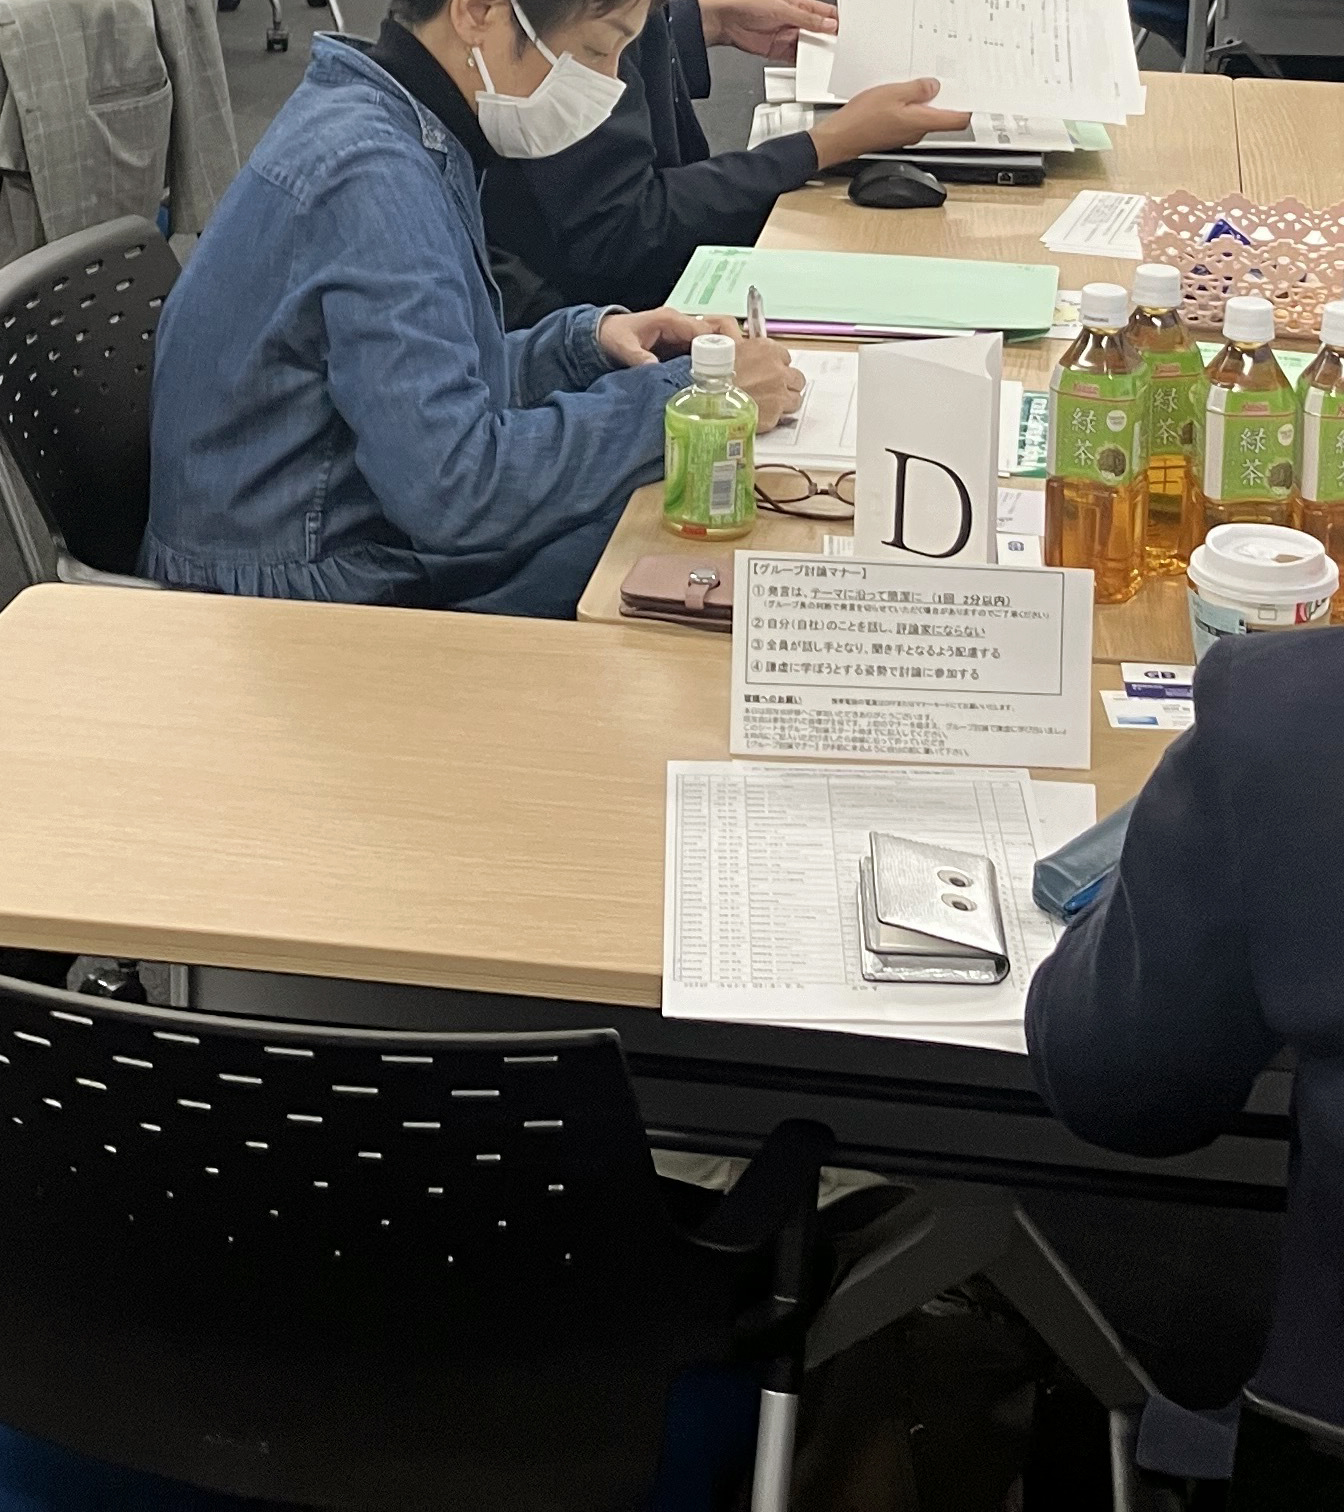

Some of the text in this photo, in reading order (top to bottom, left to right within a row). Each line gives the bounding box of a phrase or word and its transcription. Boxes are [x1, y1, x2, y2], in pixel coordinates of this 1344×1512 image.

[1071, 407, 1097, 466] 緑茶
[1240, 427, 1268, 486] 緑茶
[881, 447, 973, 559] D
[752, 562, 867, 580] 【グループ討論マナー】
